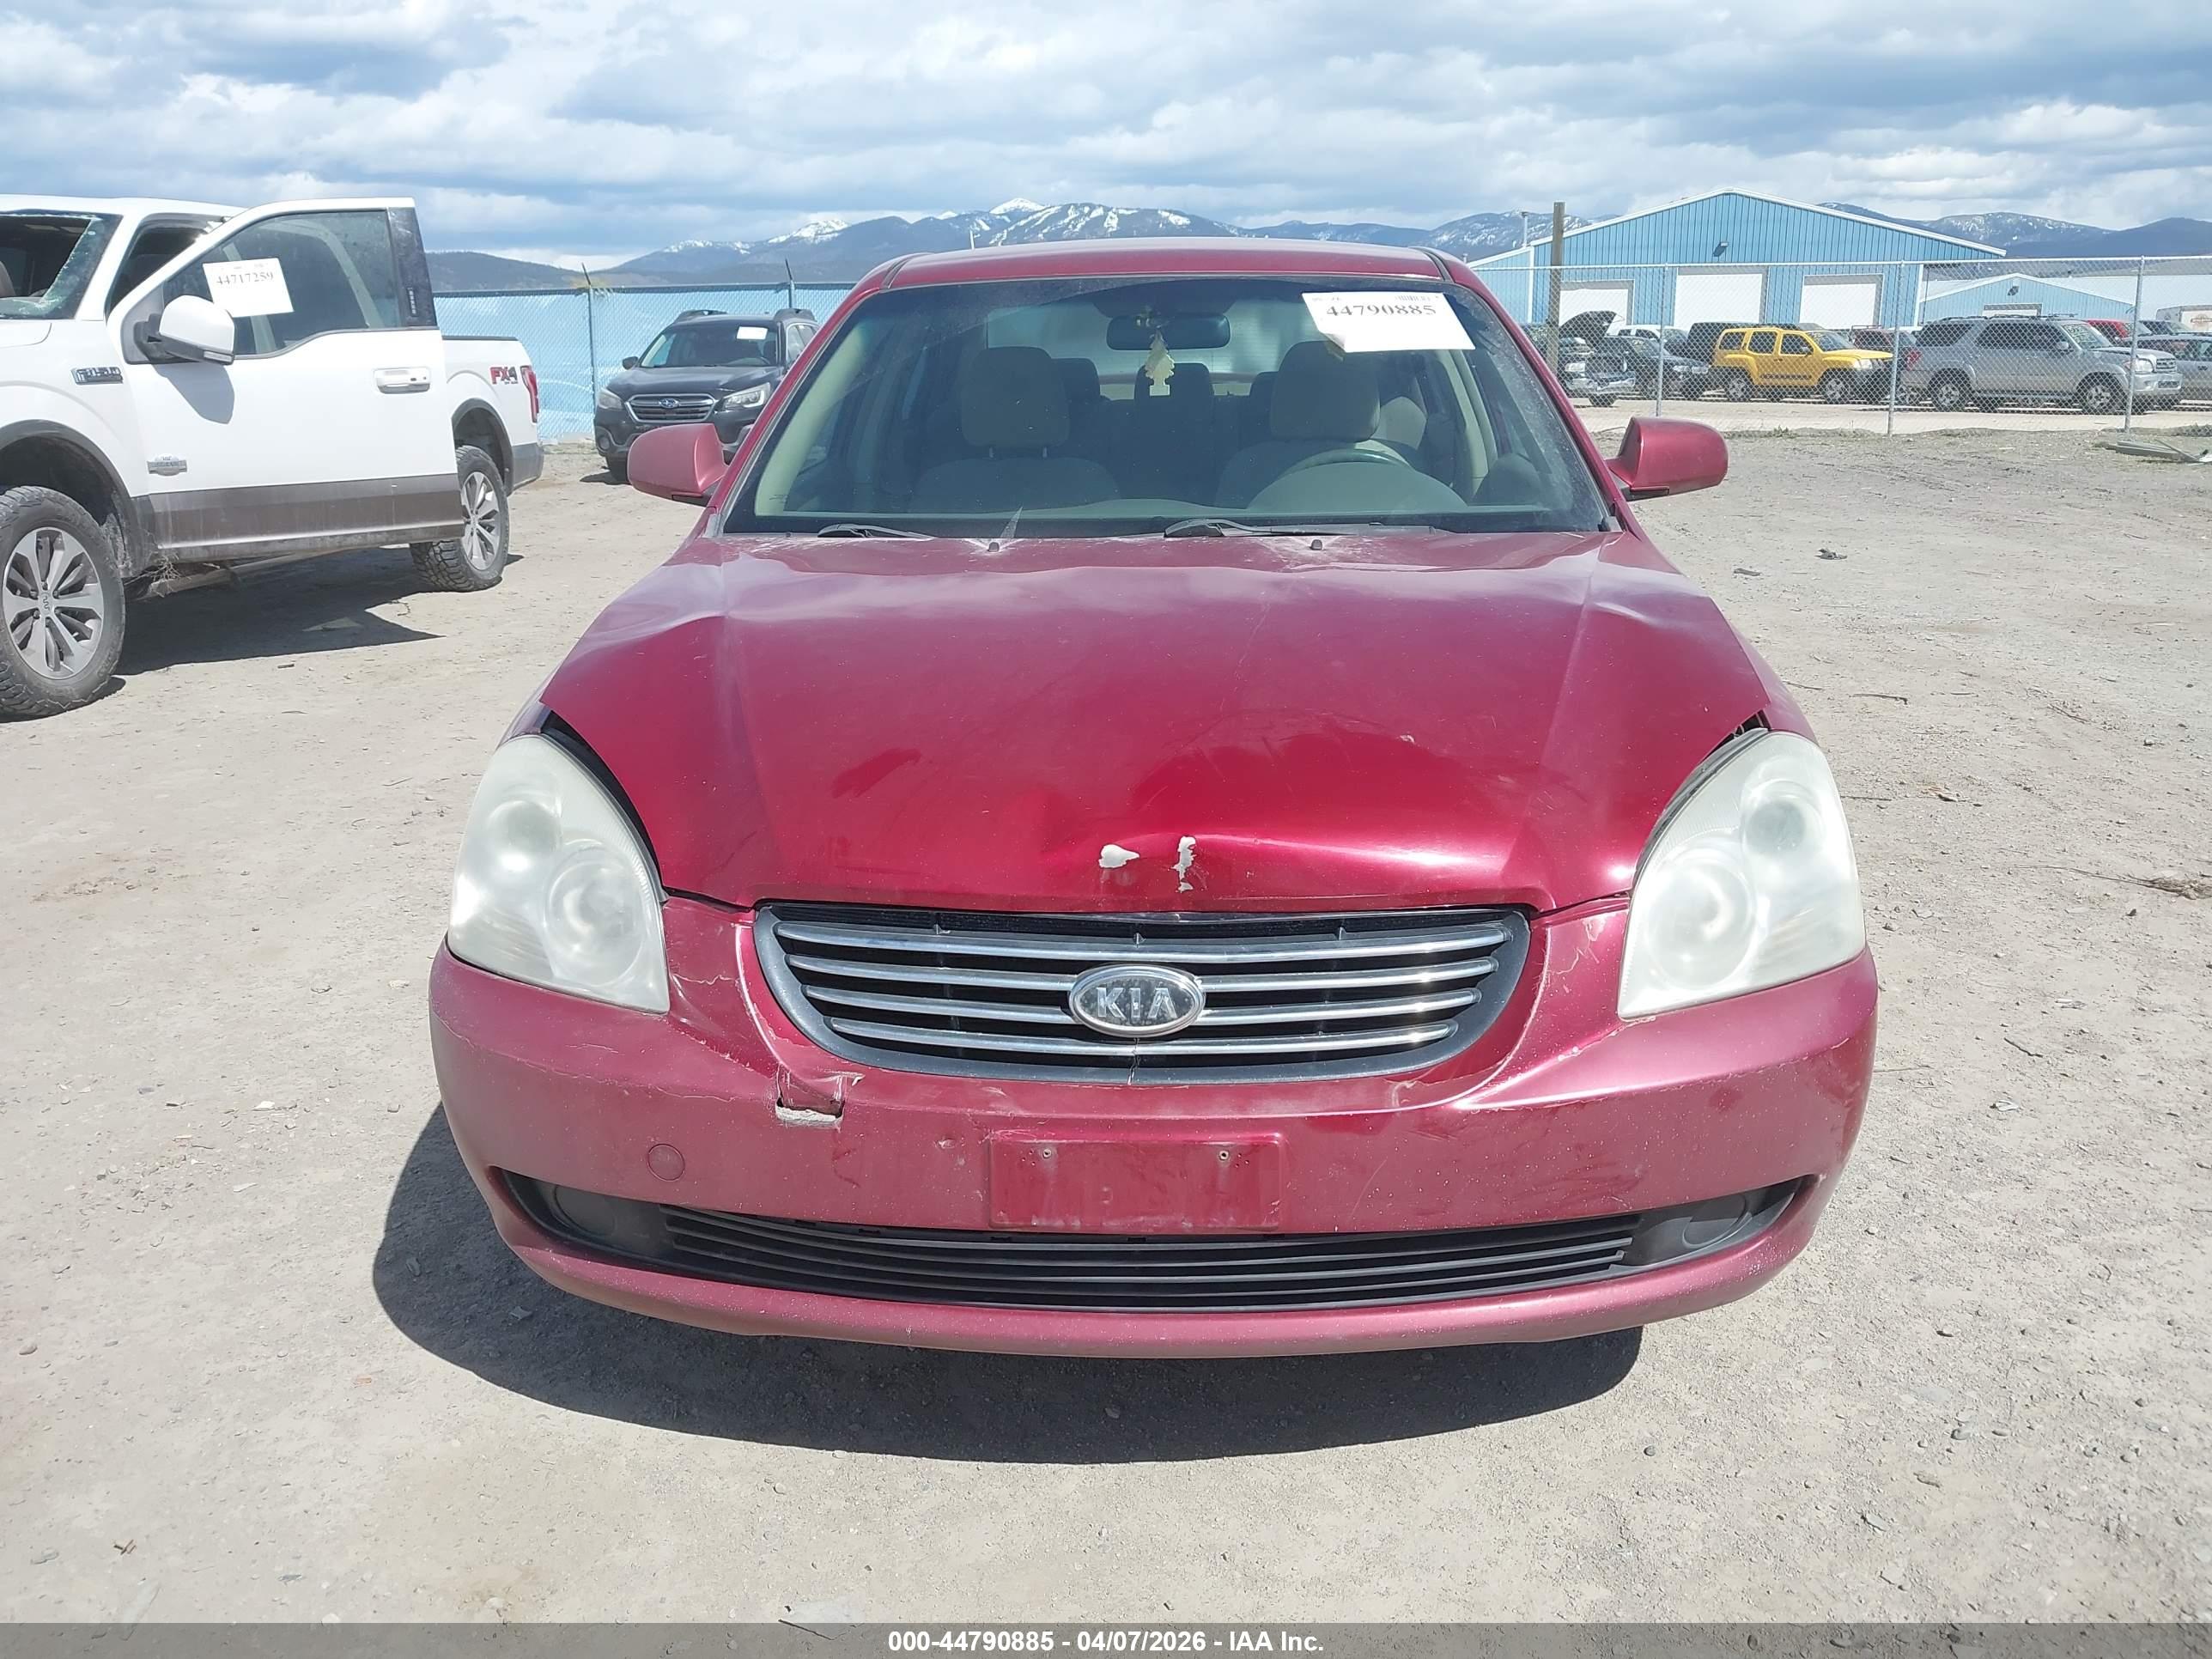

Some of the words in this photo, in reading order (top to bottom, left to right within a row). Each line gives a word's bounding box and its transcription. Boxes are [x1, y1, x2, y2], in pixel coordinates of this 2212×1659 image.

[216, 271, 274, 286] 44717259
[1326, 305, 1437, 317] 44790885
[489, 366, 518, 385] FX4
[1096, 987, 1177, 1019] KIA
